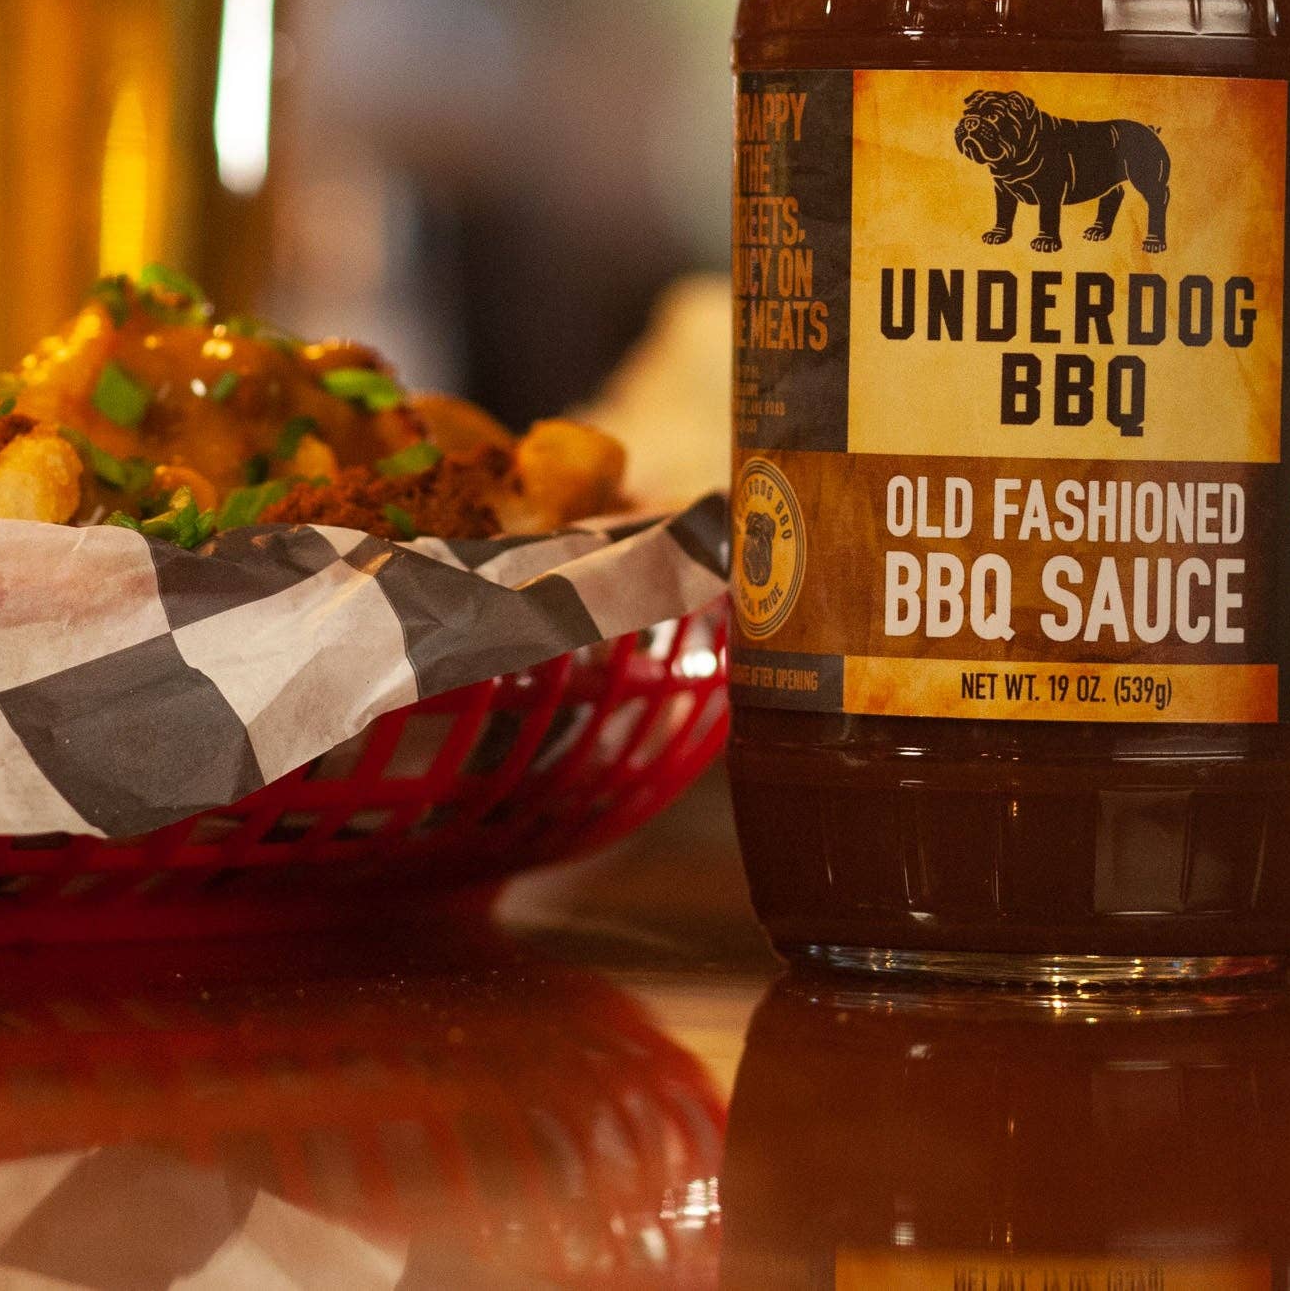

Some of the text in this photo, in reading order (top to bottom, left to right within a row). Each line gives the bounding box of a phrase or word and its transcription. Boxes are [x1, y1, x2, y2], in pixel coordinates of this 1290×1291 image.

[739, 92, 806, 141] RAPPY
[735, 247, 814, 298] UCY ON
[750, 300, 829, 351] MEATS
[880, 268, 1257, 348] UNDERDOG
[1000, 352, 1146, 437] BBQ
[886, 475, 973, 539] OLD
[993, 478, 1246, 544] FASHIONED
[884, 550, 1016, 641] BBQ
[1040, 555, 1246, 644] SAUCE
[961, 672, 1173, 710] NET WT. 19 OZ. (539g)
